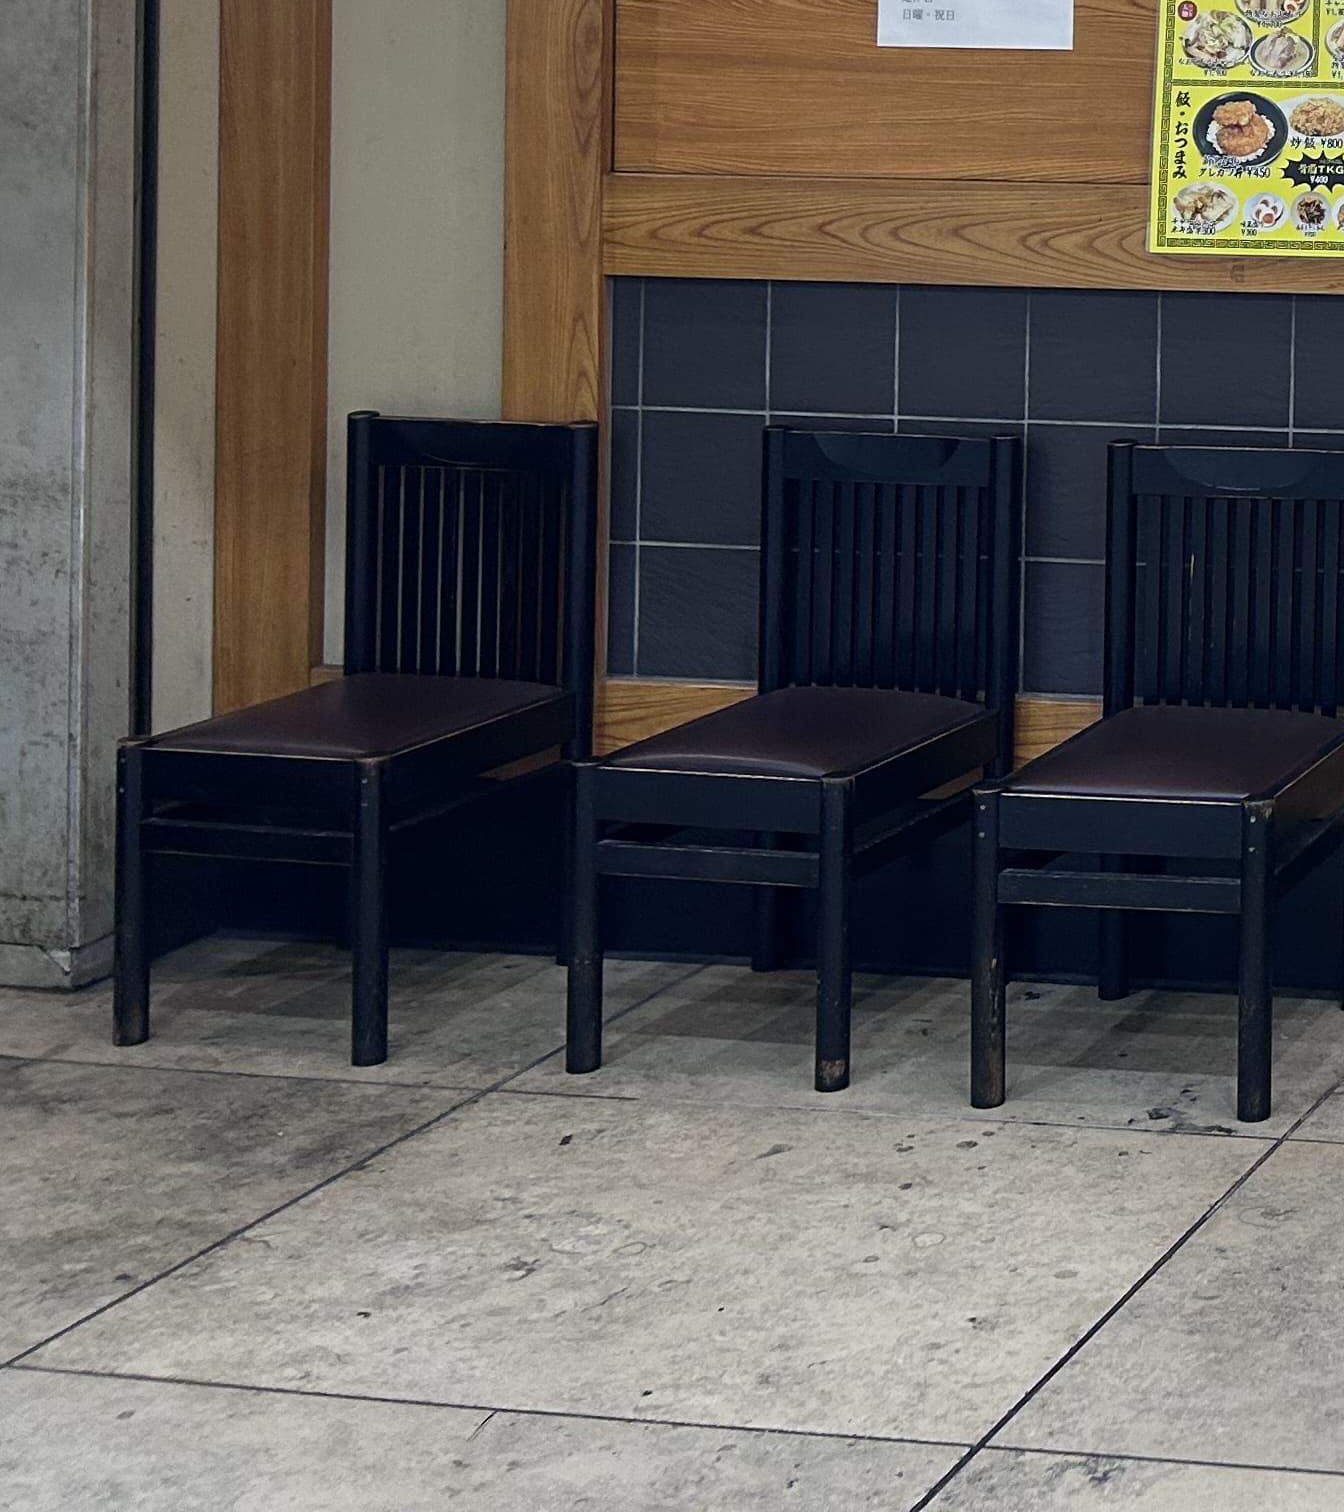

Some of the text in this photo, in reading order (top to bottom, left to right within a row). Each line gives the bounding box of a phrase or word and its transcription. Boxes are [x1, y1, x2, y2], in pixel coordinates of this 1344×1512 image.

[902, 9, 955, 21] 日曜・祝日
[1173, 90, 1191, 179] 飯・おつまみ
[1290, 137, 1344, 150] 炒飯 ¥800
